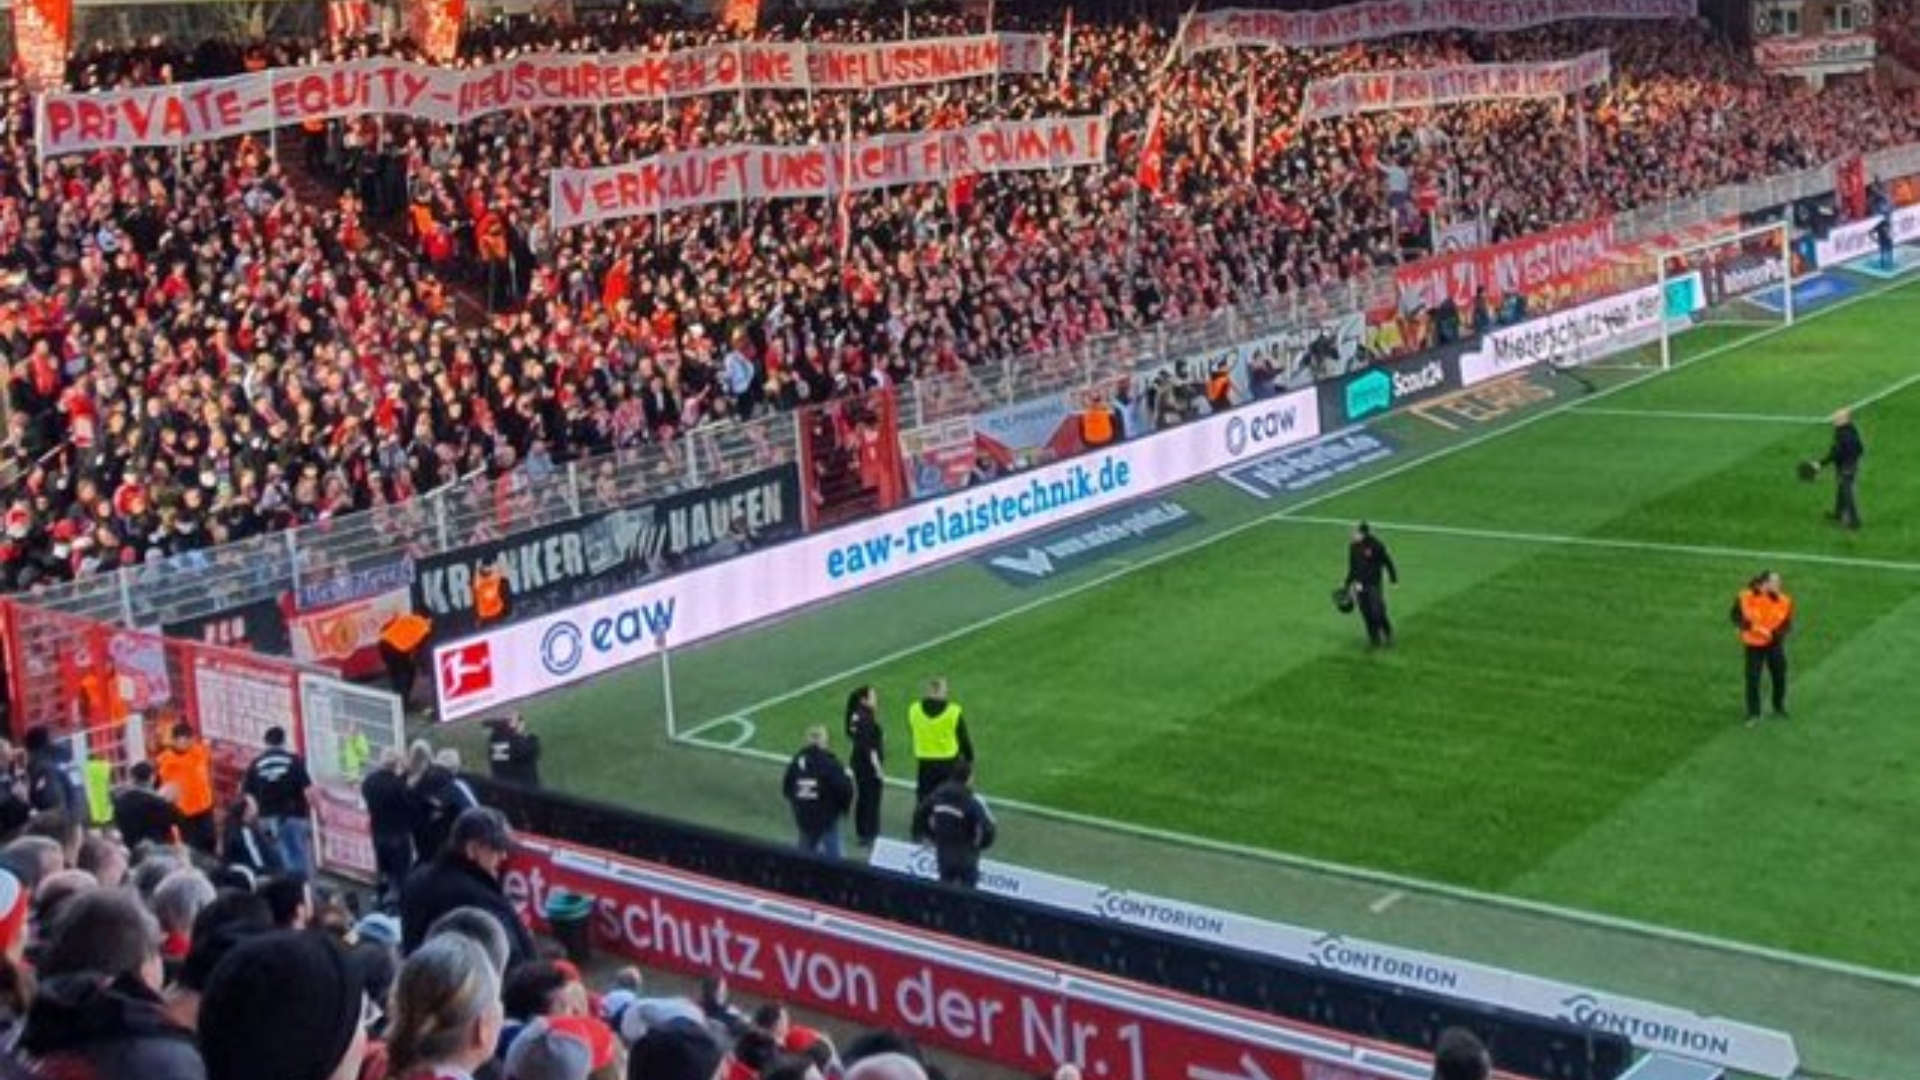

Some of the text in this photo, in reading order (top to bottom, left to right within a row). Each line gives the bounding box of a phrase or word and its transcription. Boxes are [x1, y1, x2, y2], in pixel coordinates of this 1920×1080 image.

[716, 49, 795, 87] OHNE
[560, 150, 749, 216] VERKAUFT
[761, 150, 826, 190] UNS
[978, 124, 1076, 163] DUMM
[1492, 312, 1601, 364] Mieterschutz
[1250, 404, 1298, 441] eaw
[826, 454, 1130, 579] eaw-relaistechnik.de
[420, 532, 583, 614] KRNKER
[670, 480, 783, 554] HAUFEN
[590, 595, 677, 653] eaw
[1106, 894, 1224, 936] CONTORION
[1322, 944, 1457, 988] CONTORION
[774, 943, 880, 1013] von
[895, 966, 1004, 1045] der
[1573, 1002, 1730, 1056] CONTORION
